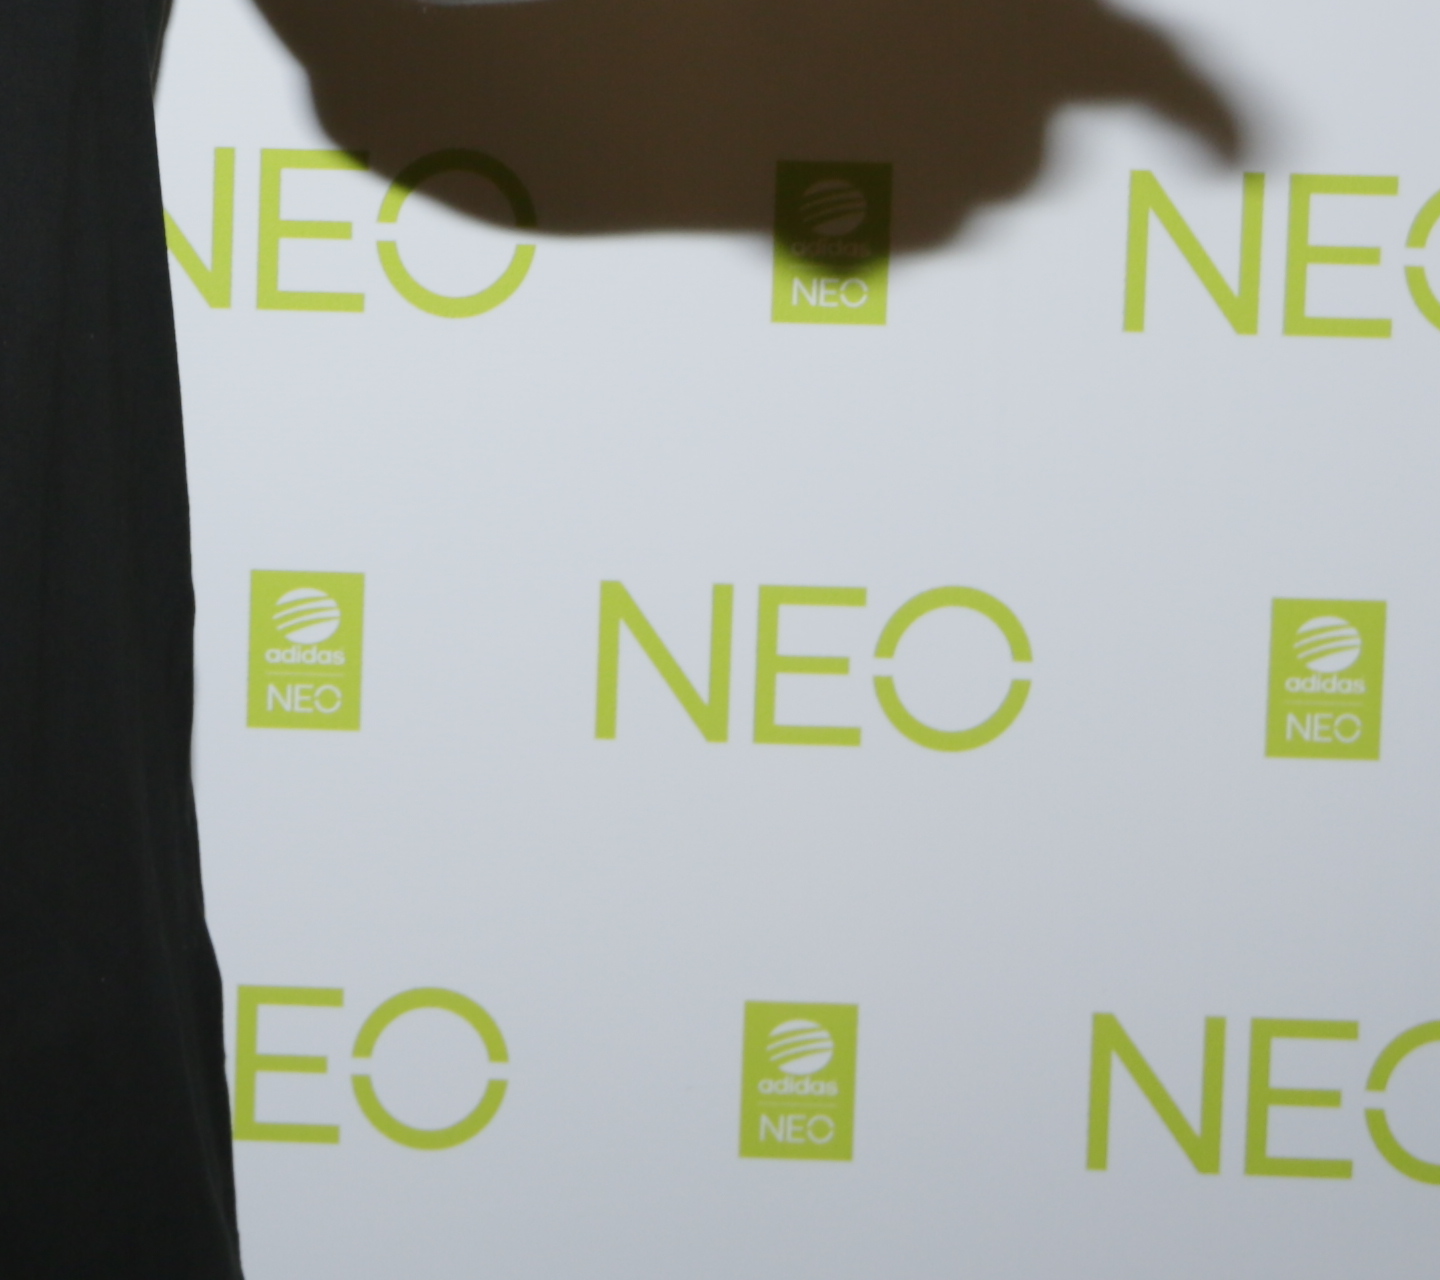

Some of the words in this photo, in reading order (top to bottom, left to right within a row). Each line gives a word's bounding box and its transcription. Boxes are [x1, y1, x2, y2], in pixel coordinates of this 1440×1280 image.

[790, 276, 870, 309] NEO
[264, 643, 346, 665] adidas
[596, 581, 1032, 752] NEO
[265, 681, 342, 714] NEO
[1285, 672, 1367, 693] adidas
[1285, 710, 1363, 742] NEO
[232, 984, 509, 1151] EO
[757, 1074, 839, 1095] adidas
[758, 1112, 835, 1144] NEO
